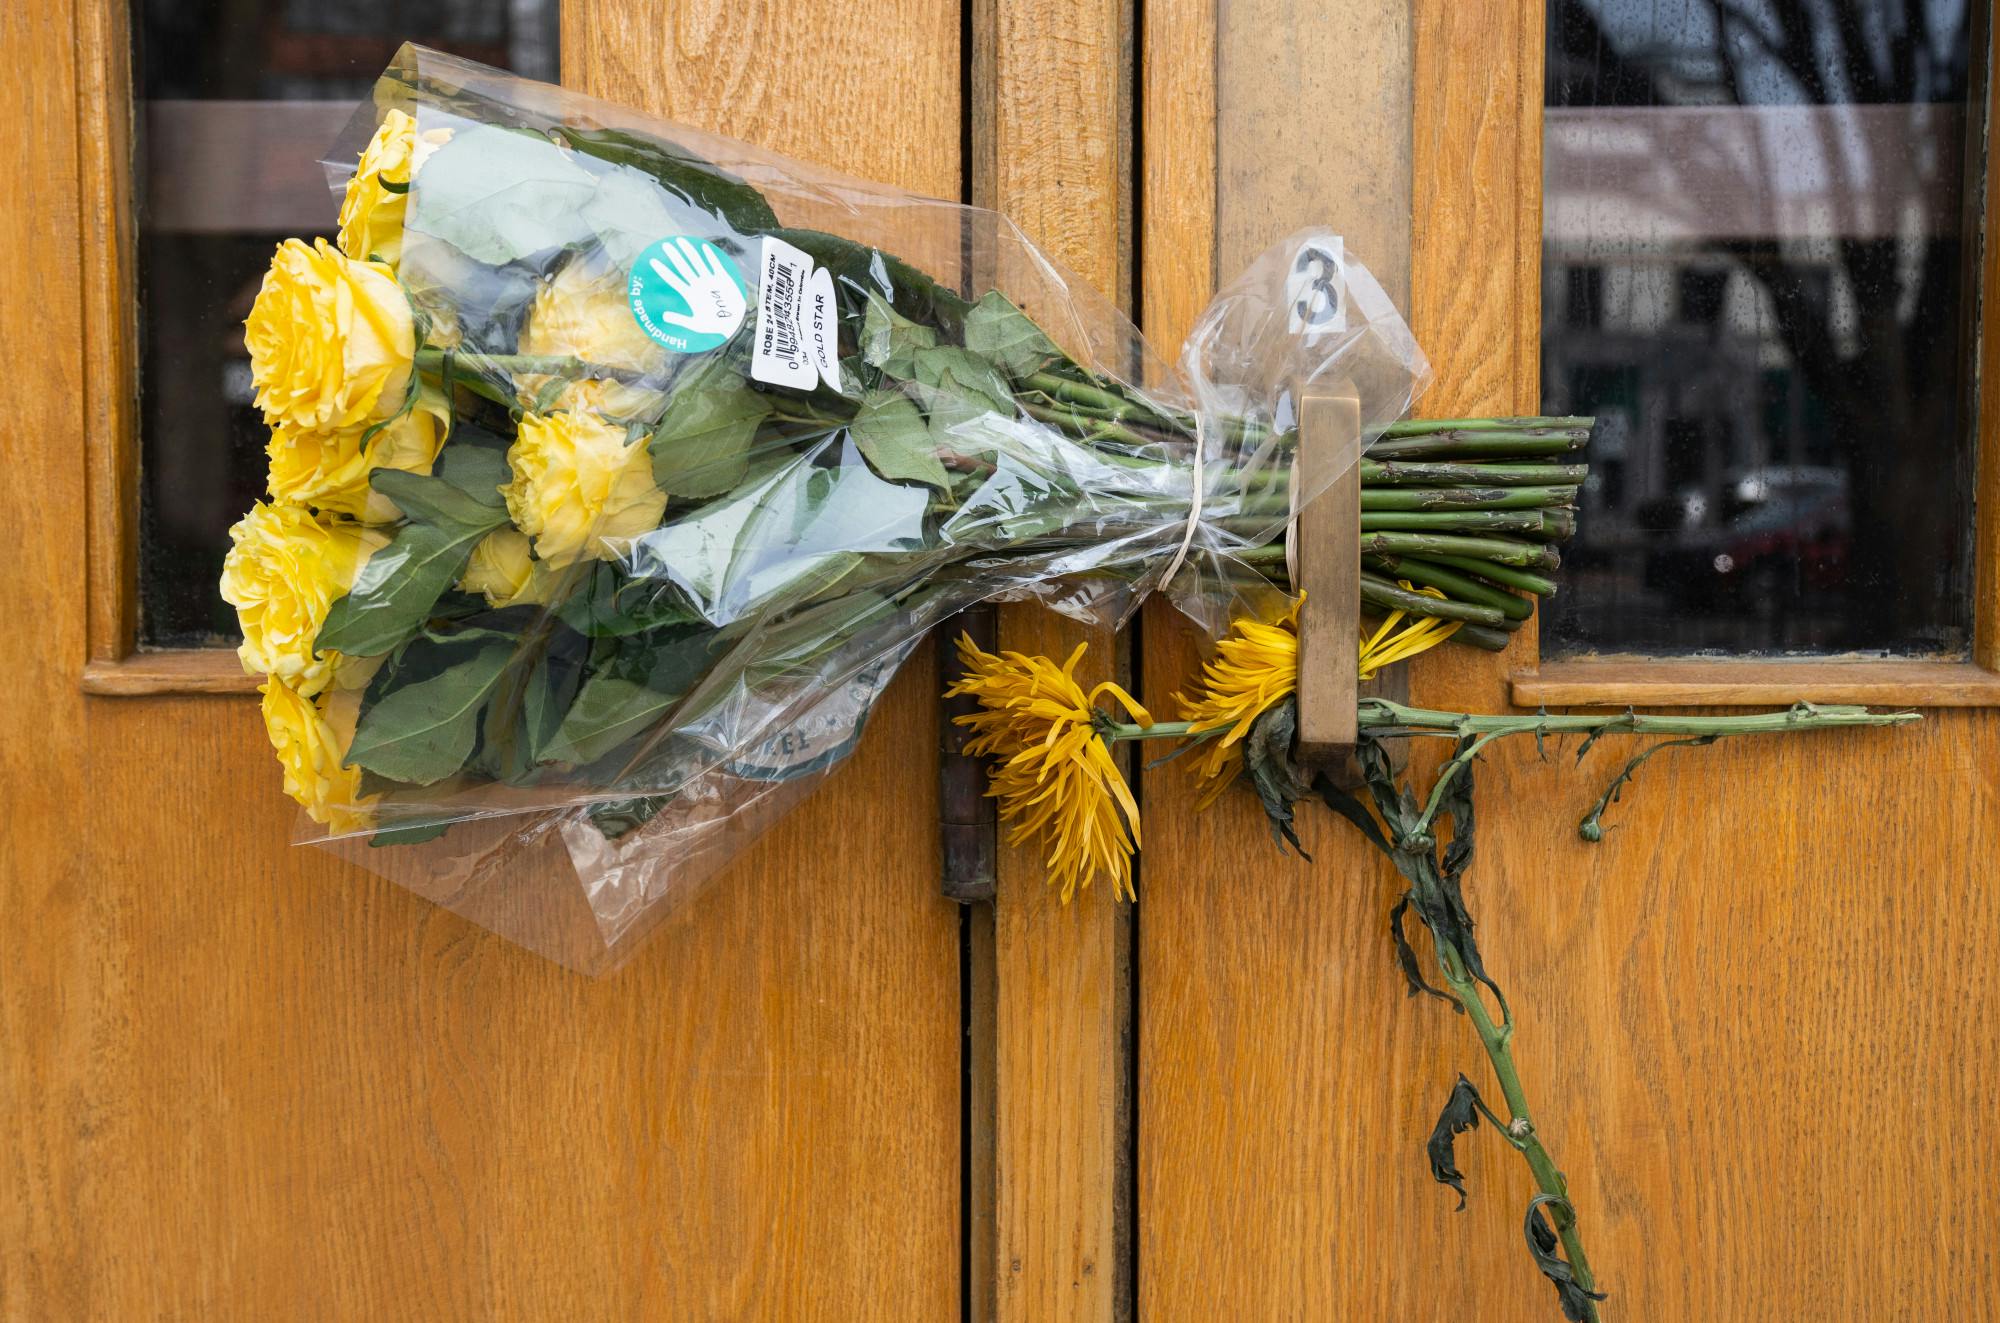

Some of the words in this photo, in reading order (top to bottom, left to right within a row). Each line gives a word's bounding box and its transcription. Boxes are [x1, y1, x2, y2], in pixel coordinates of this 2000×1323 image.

[630, 276, 643, 296] by:
[1296, 248, 1337, 325] 3
[633, 299, 687, 349] Handmade
[814, 294, 824, 331] STAR
[763, 327, 774, 356] ROSE
[815, 333, 828, 369] GOLD
